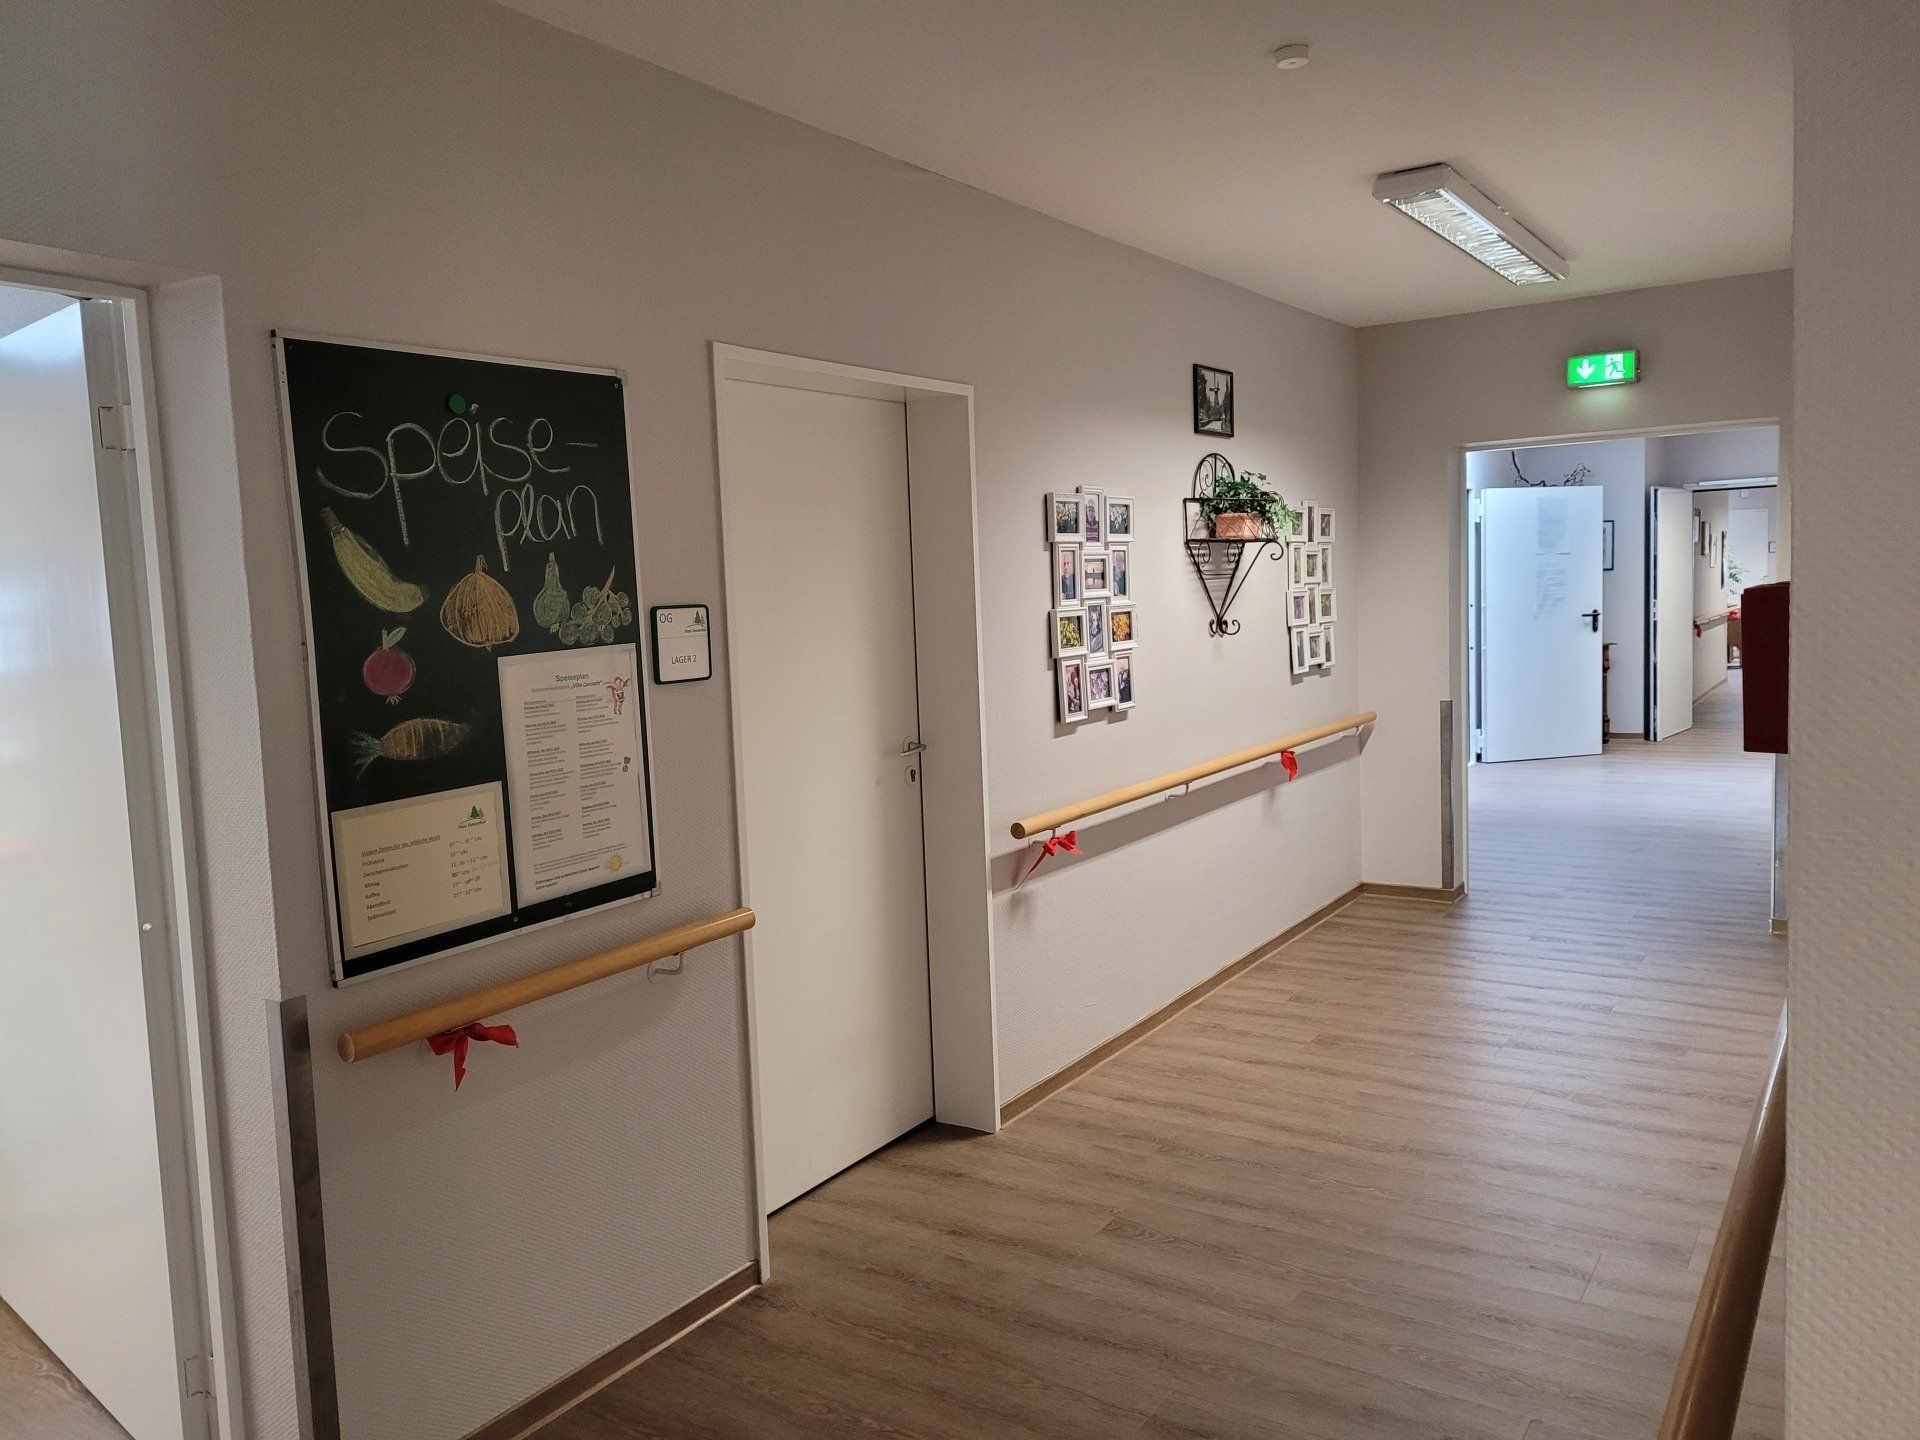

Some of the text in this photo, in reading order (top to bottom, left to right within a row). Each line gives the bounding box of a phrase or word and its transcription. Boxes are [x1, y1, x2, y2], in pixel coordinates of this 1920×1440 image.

[315, 403, 600, 547] Speise-
[494, 483, 604, 572] plan
[659, 612, 673, 624] OG
[671, 654, 698, 665] LAGER 2
[555, 673, 590, 684] Speiseplan
[362, 857, 385, 867] Frühstück
[363, 863, 410, 878] Zwischenmahlzeiten
[364, 881, 381, 889] Mittag
[365, 891, 381, 899] Kaffee
[366, 900, 391, 911] Abendbrot
